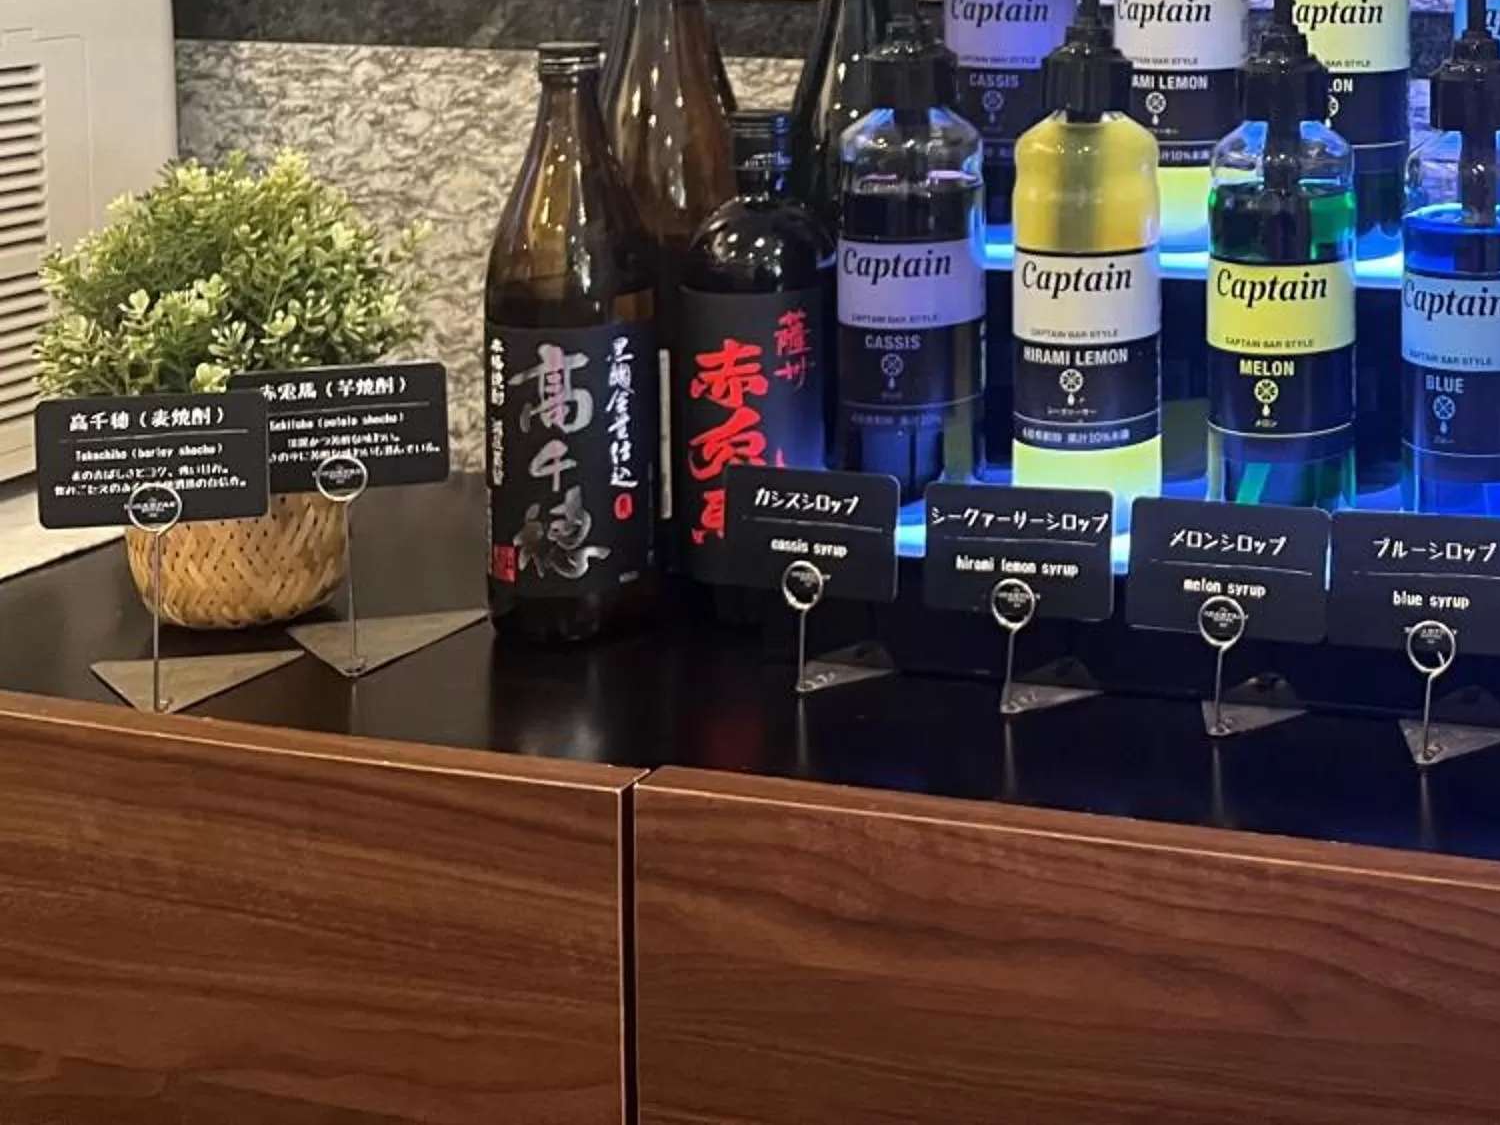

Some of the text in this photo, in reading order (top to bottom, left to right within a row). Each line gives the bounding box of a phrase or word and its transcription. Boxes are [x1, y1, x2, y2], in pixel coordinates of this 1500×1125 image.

[969, 73, 1020, 88] CASSIS
[1131, 74, 1209, 90] AMI LEMON
[843, 248, 951, 285] Captain
[1022, 261, 1132, 299] Captain
[1217, 268, 1328, 307] Captain
[865, 334, 921, 350] CASSIS
[1023, 346, 1129, 365] HIRAMI LEMON
[1239, 358, 1295, 376] MELON
[1425, 374, 1465, 394] BLUE
[755, 487, 860, 516] カシスシロップ
[770, 538, 848, 559] cassis syrup
[1168, 529, 1288, 556] メロンシロップ
[1372, 537, 1498, 564] ブルーシロップ
[956, 554, 1079, 577] hirami lemon syrup
[1183, 578, 1266, 598] melon syrup
[1393, 590, 1470, 611] blue syrup
